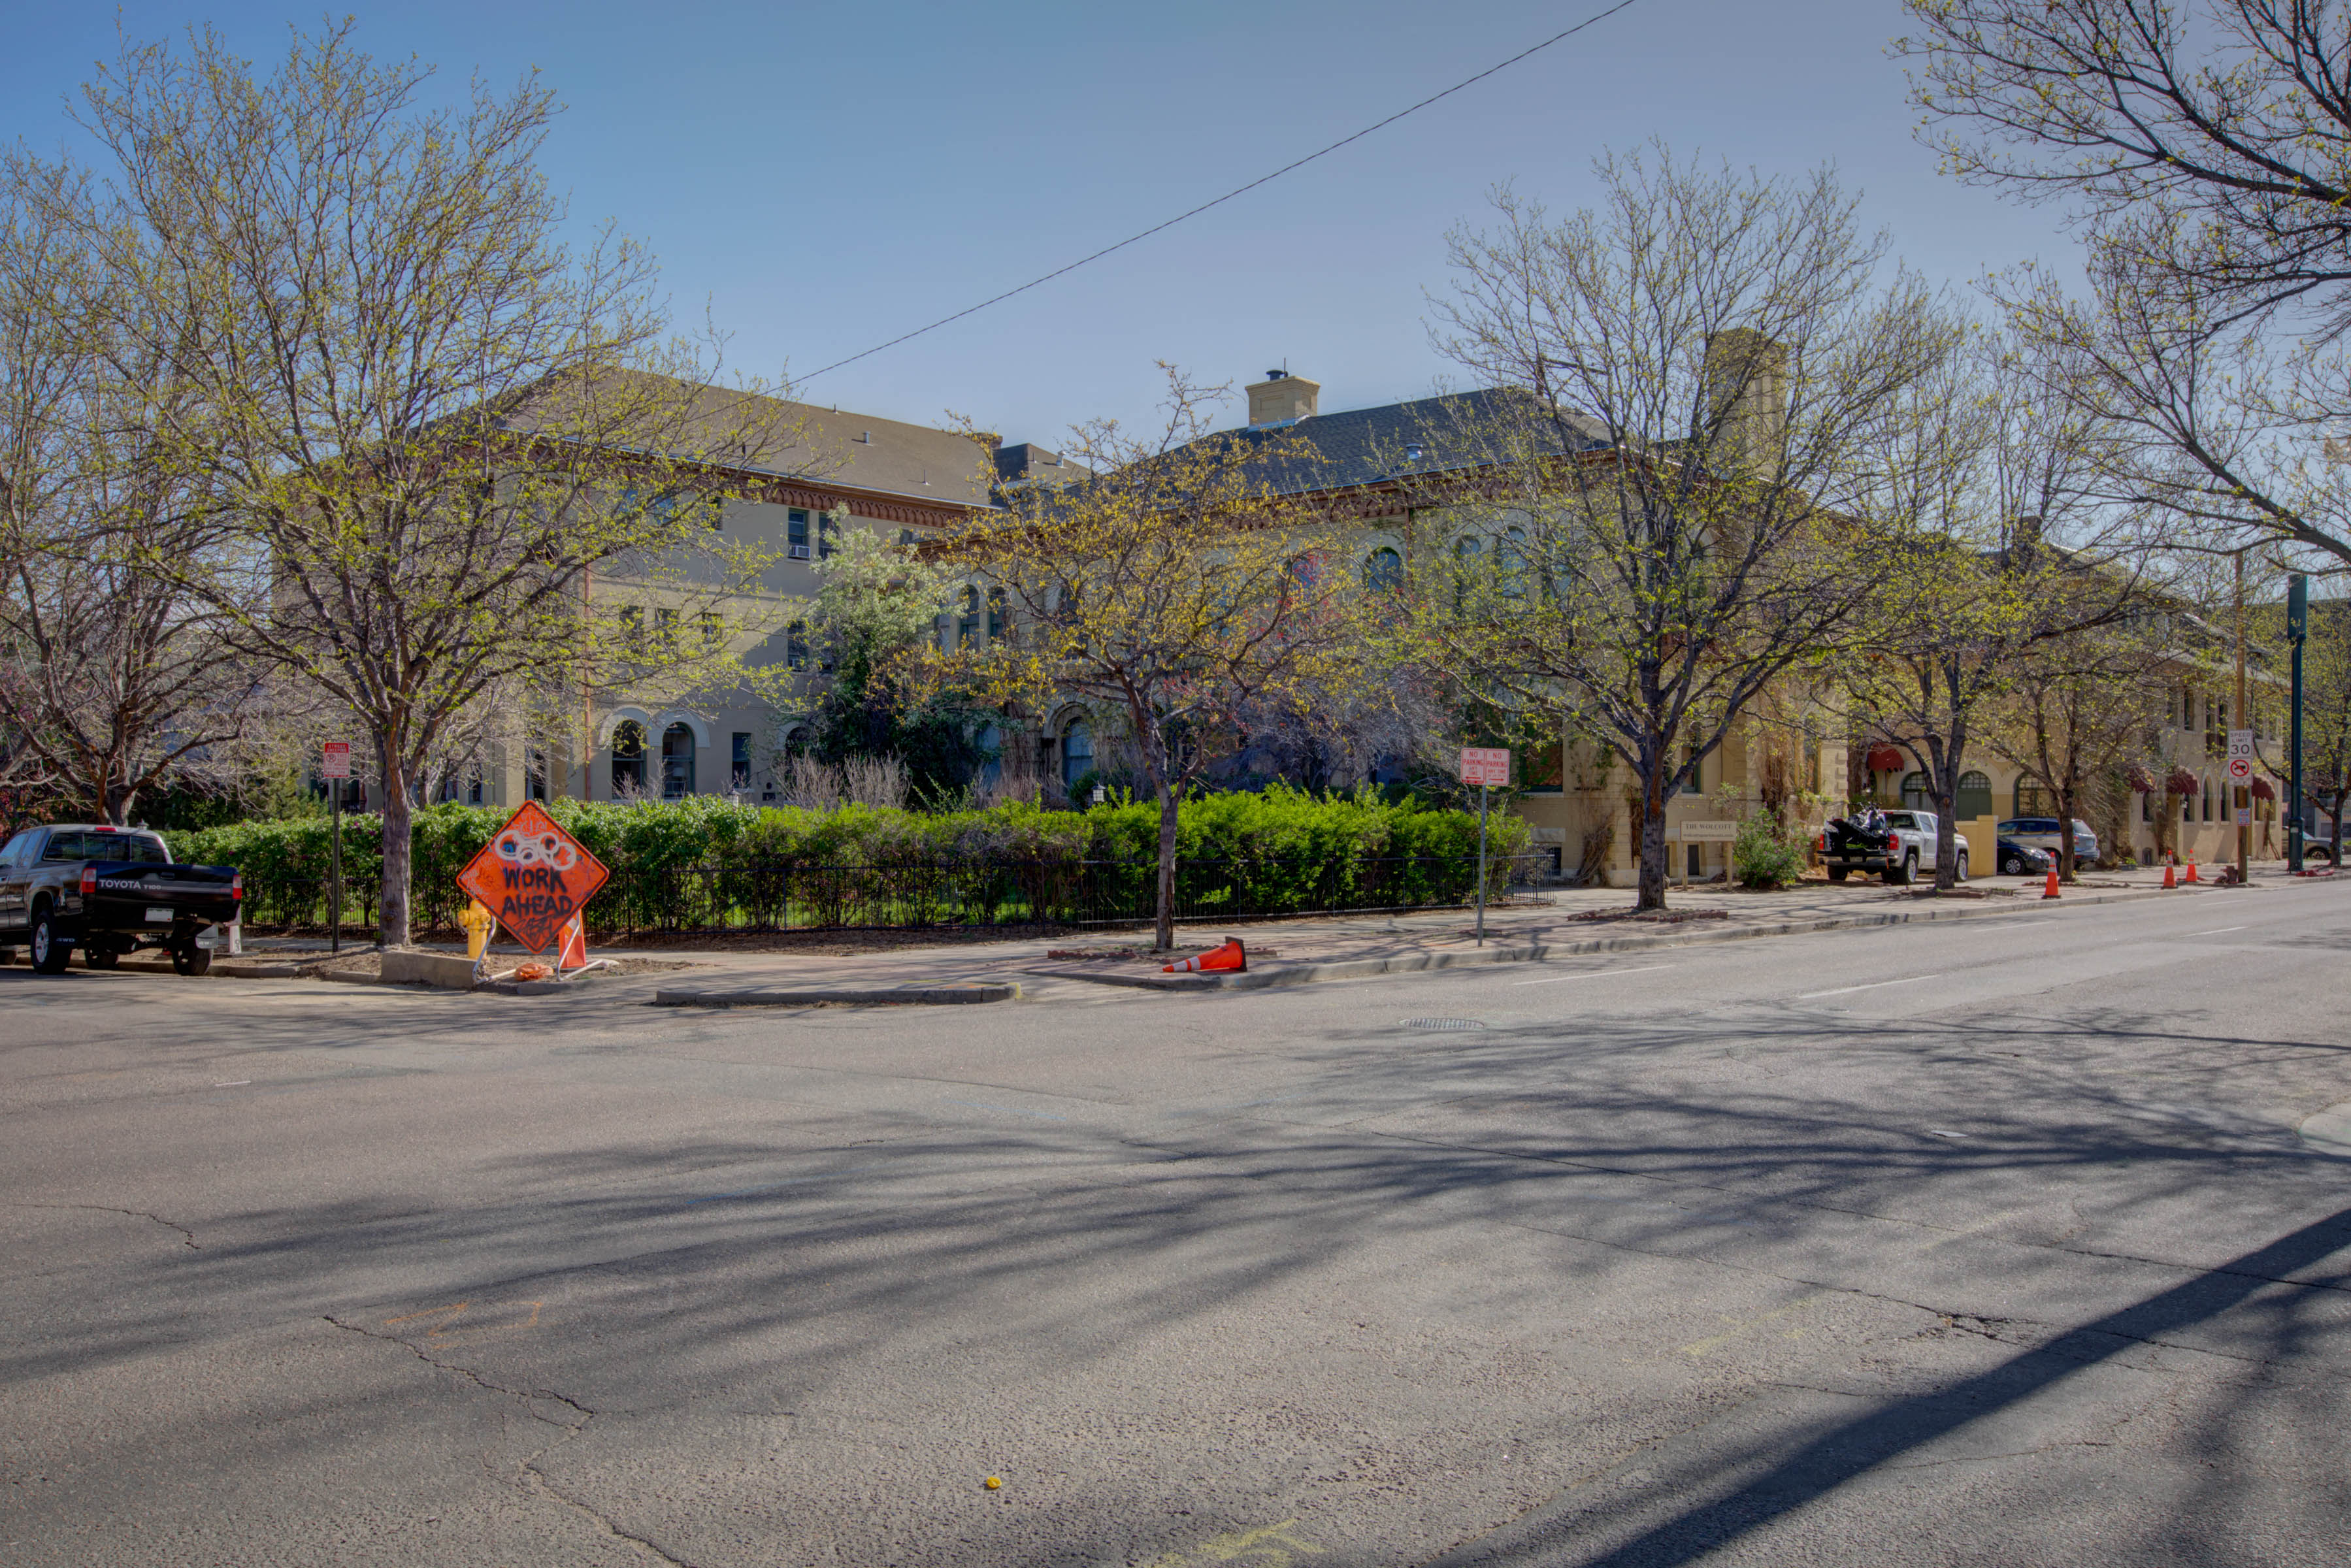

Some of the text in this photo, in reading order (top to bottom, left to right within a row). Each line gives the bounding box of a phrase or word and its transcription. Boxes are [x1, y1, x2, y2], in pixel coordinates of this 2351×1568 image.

[2231, 744, 2250, 755] 30
[99, 879, 141, 889] TOYOTA
[504, 867, 568, 893] WORK
[502, 895, 573, 919] AHEAD
